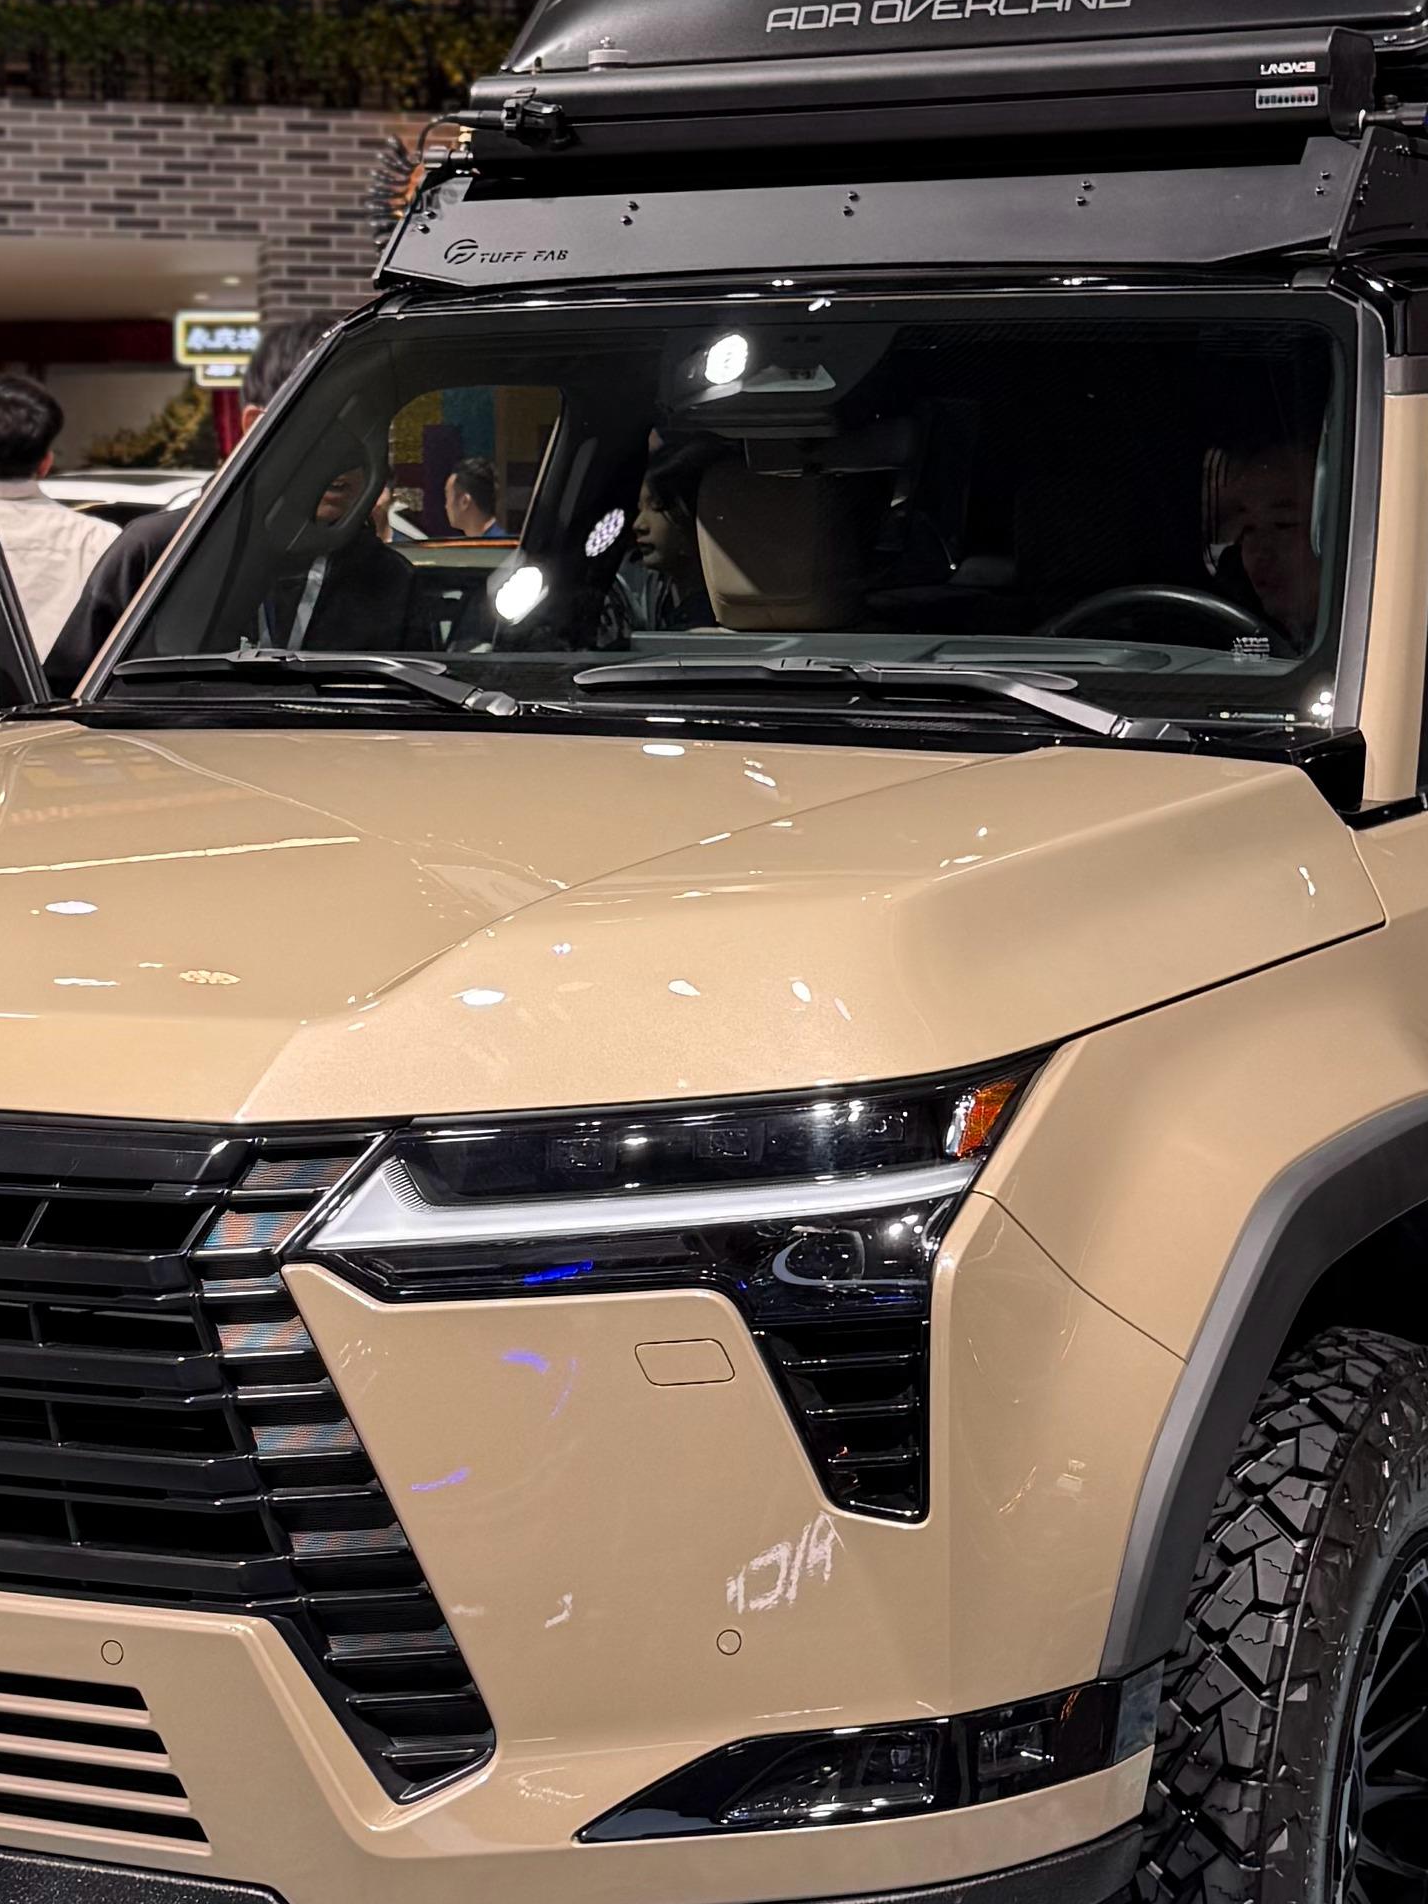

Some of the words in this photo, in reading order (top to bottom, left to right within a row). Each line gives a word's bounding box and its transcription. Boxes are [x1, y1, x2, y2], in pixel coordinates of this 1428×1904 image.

[766, 2, 862, 32] ADA
[480, 251, 527, 264] TUFF
[533, 250, 569, 262] FAB
